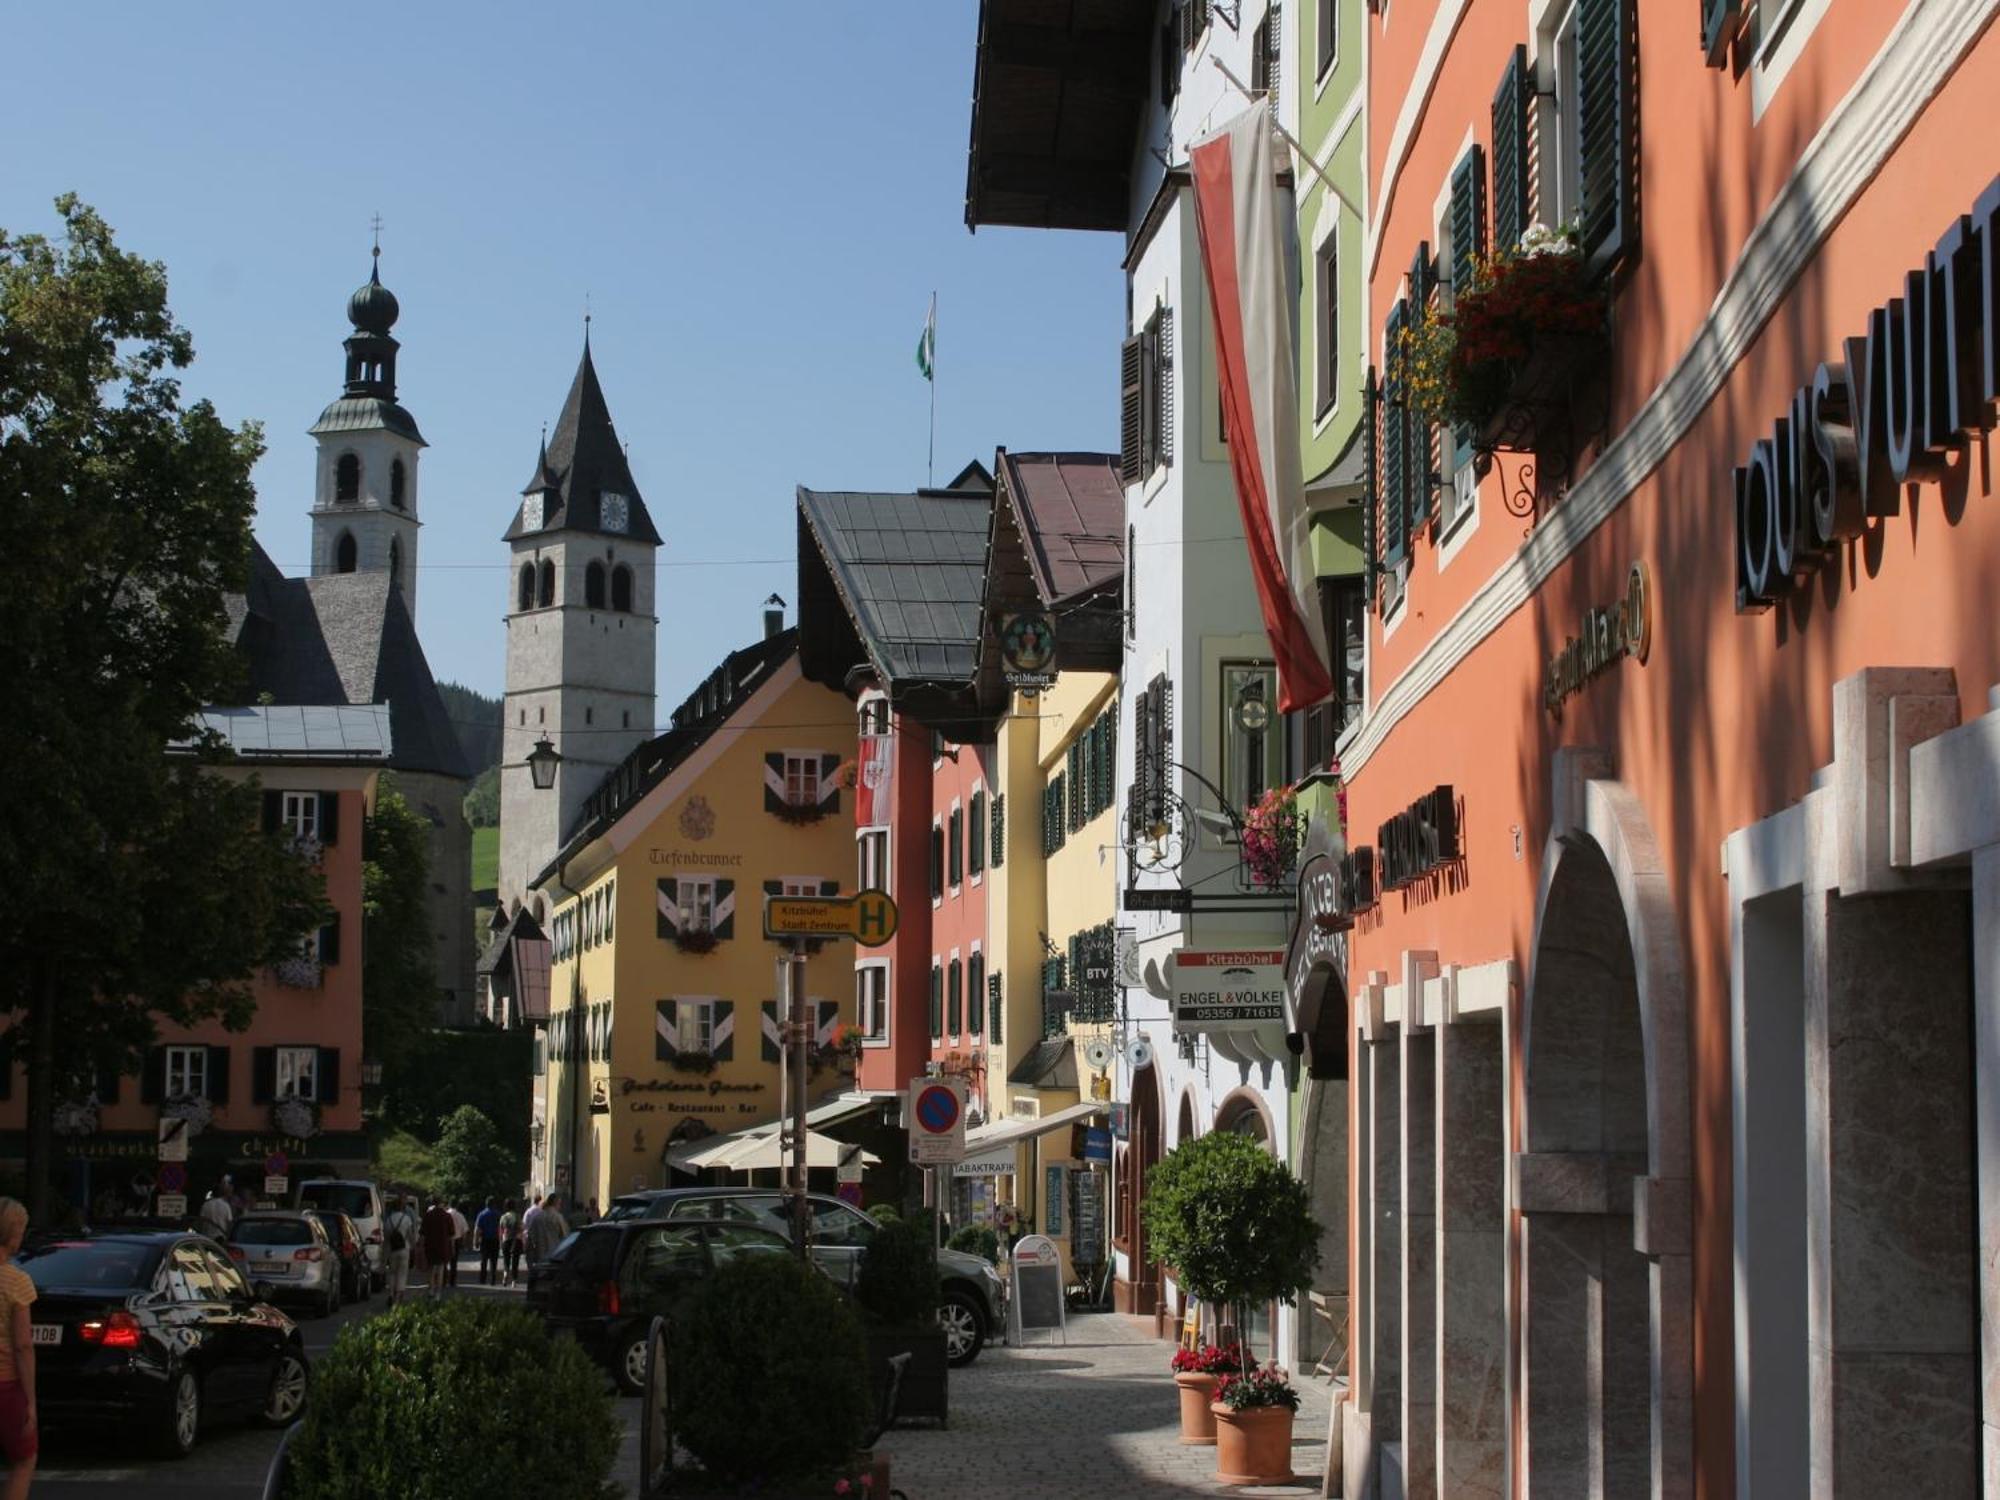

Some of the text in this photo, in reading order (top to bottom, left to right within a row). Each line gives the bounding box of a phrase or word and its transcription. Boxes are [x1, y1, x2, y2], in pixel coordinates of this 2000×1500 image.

[1732, 361, 1850, 614] LOUIS
[649, 848, 743, 867] Tiefenbrunner
[860, 900, 886, 936] H
[1206, 953, 1273, 965] Kitzbühel
[1086, 967, 1109, 979] BTV
[1197, 1008, 1233, 1019] 05356
[1245, 1007, 1281, 1018] 71615
[667, 1102, 726, 1113] Restaurant
[737, 1103, 758, 1113] Bar
